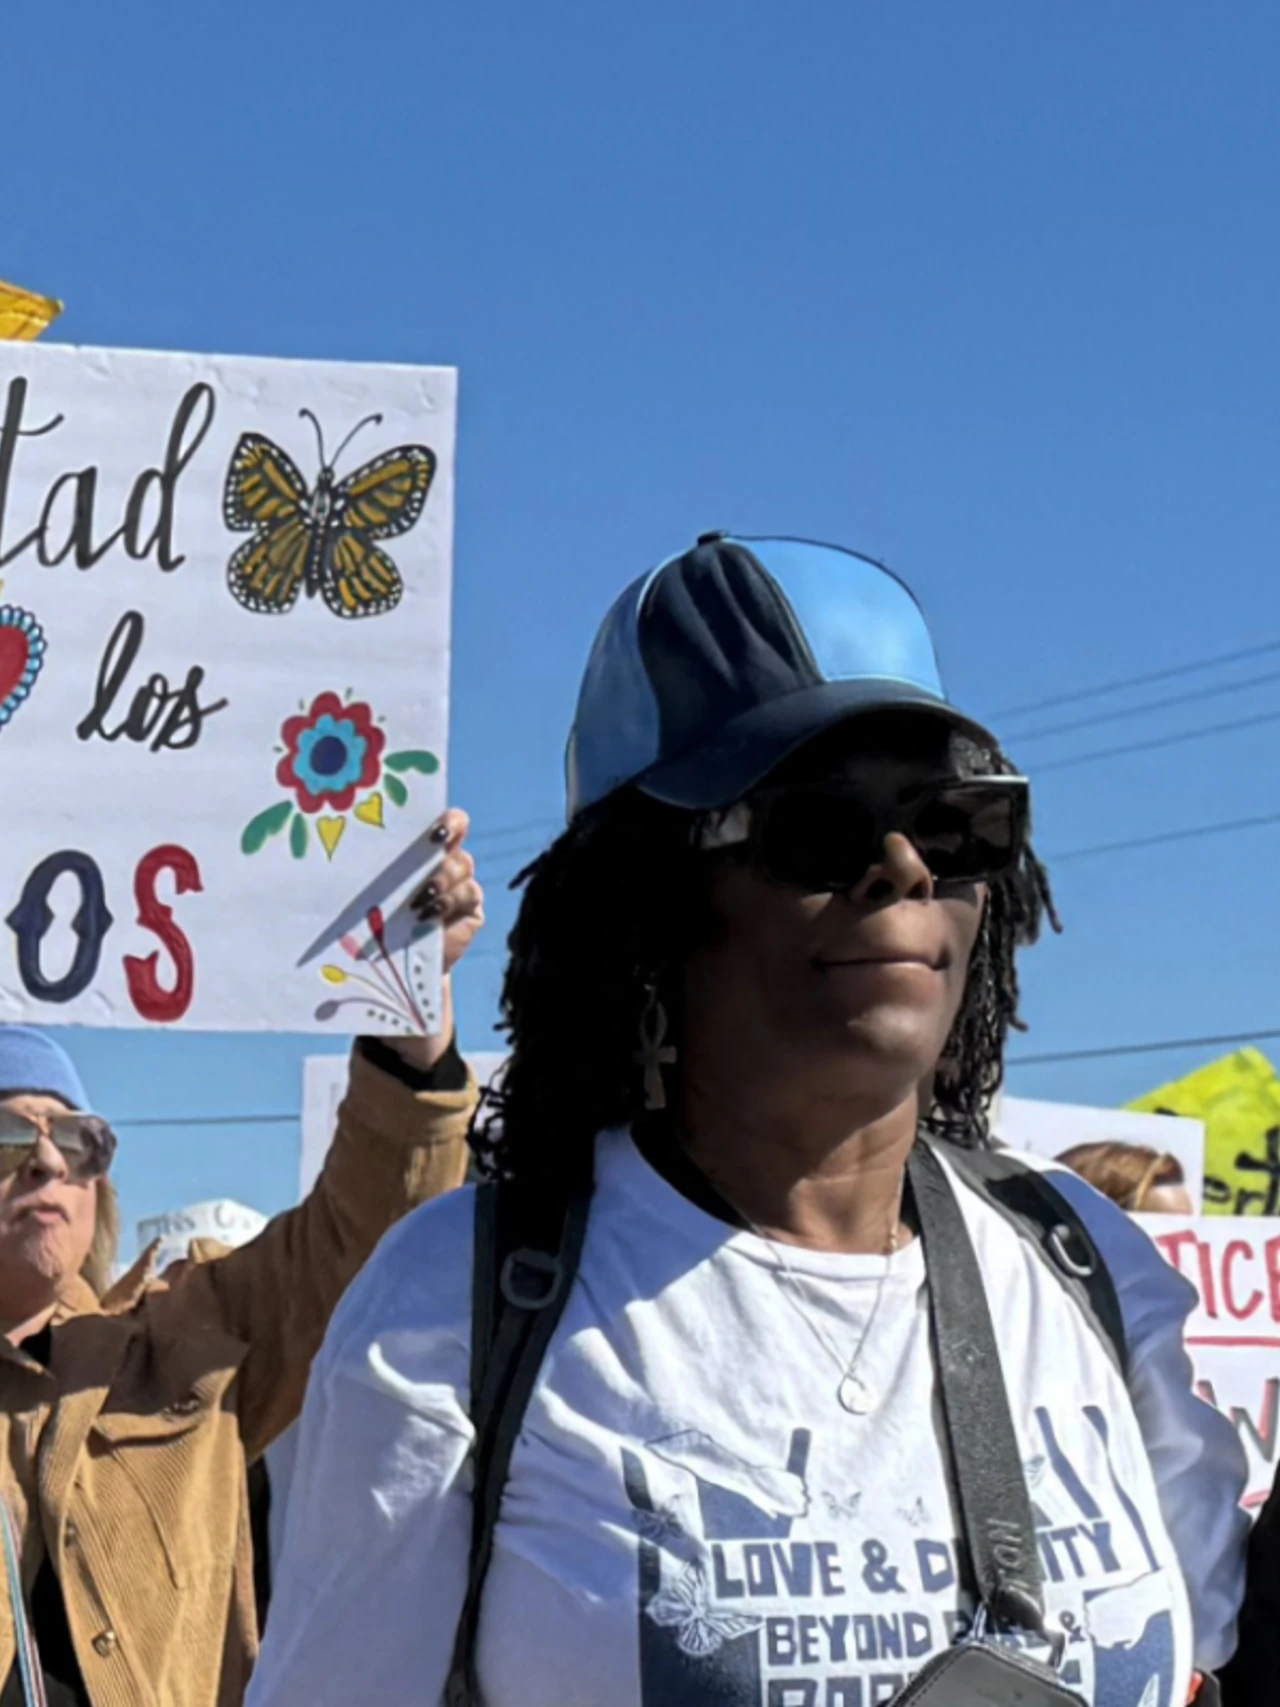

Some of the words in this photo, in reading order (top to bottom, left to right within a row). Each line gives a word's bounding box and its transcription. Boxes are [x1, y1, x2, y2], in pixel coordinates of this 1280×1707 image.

[77, 609, 228, 752] los
[711, 1541, 846, 1598] LOVE
[861, 1537, 907, 1594] &
[914, 1520, 1121, 1594] DITY
[766, 1611, 933, 1666] BEYOND
